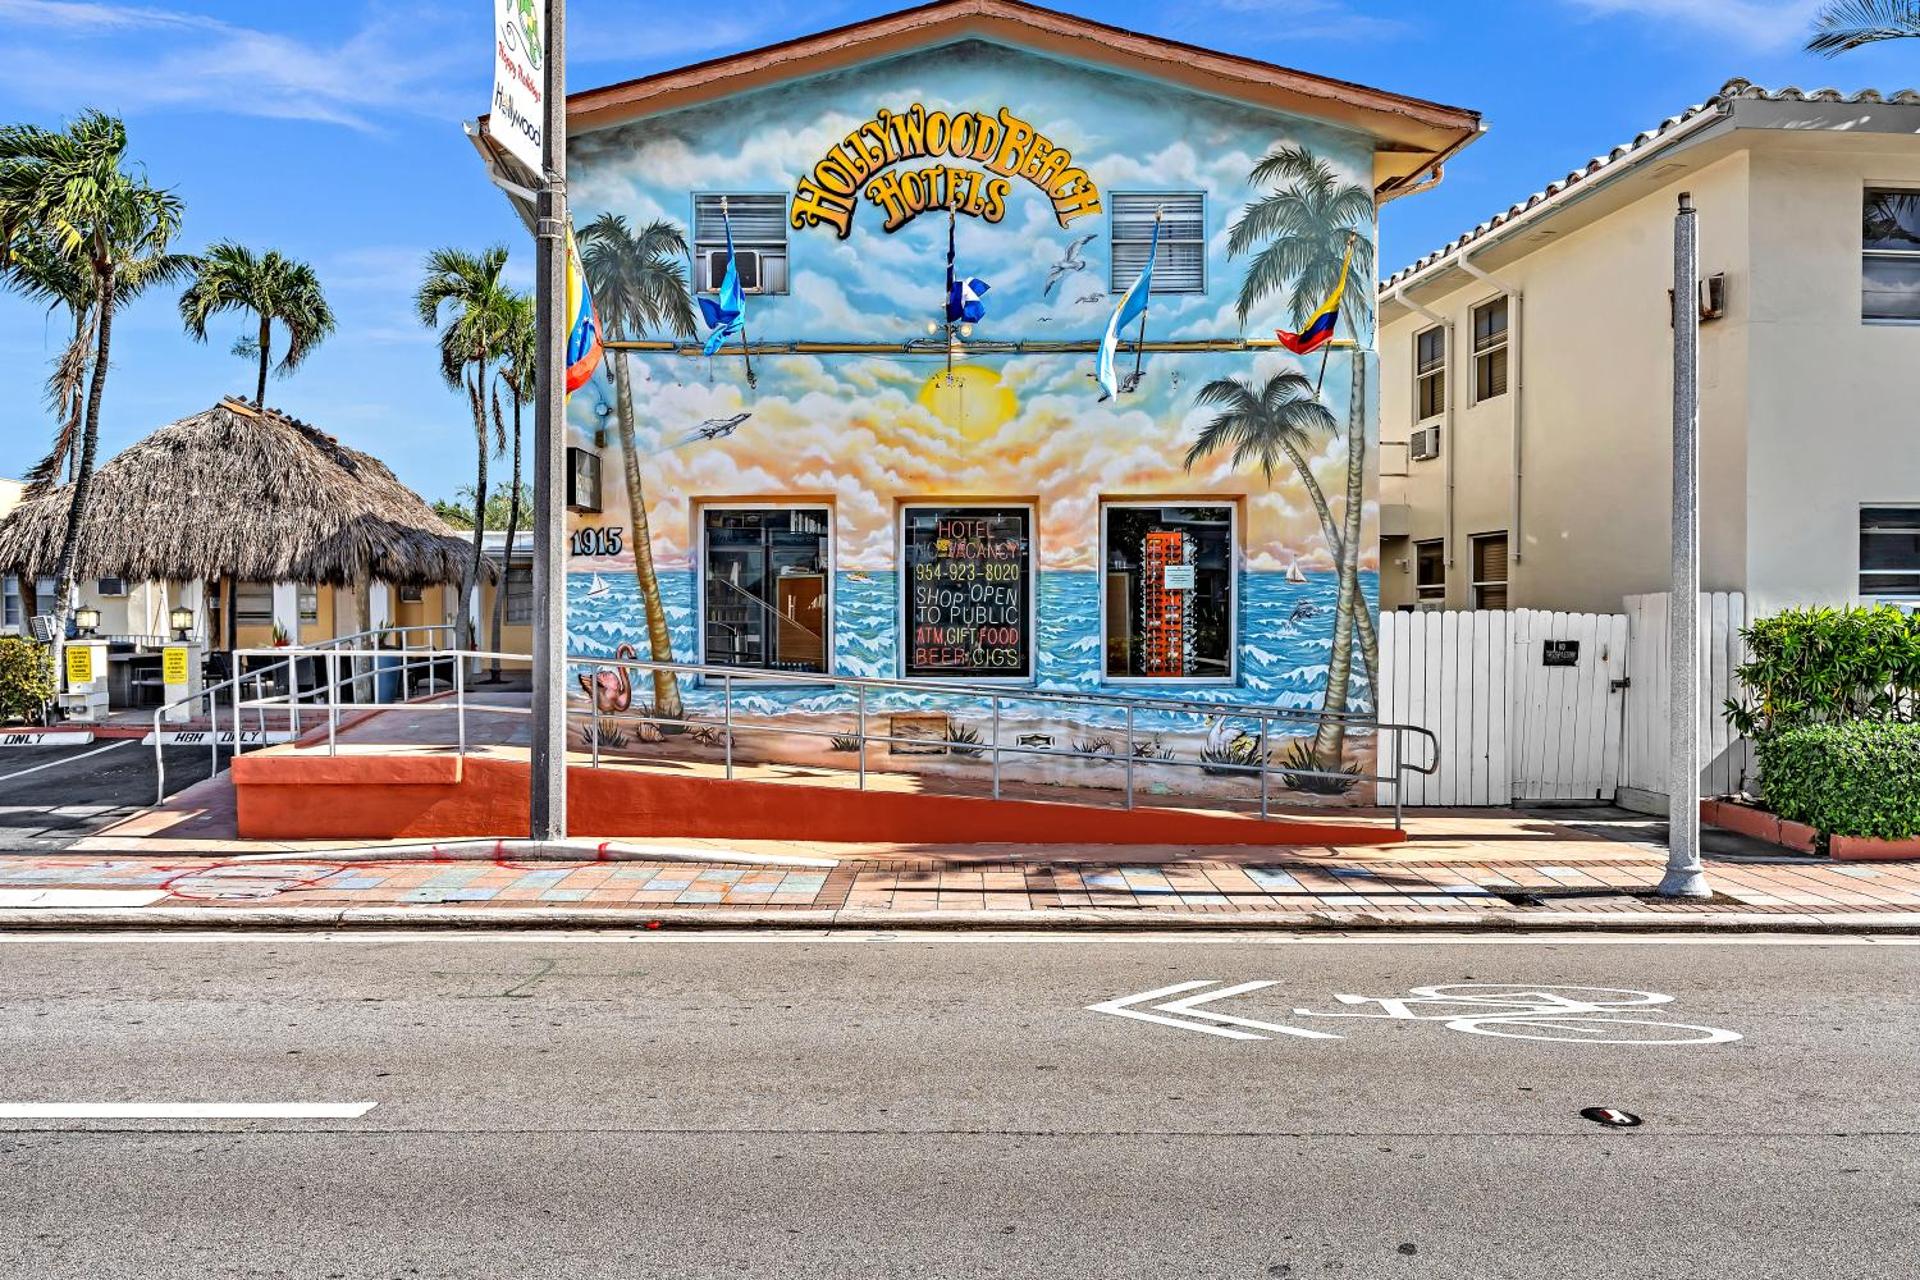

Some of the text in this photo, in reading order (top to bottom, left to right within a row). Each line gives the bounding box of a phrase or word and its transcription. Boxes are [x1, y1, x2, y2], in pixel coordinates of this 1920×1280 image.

[494, 82, 541, 148] Hollywood
[791, 103, 1103, 240] HOLLYWOOD BEACH
[865, 165, 1011, 233] HOTELS
[937, 520, 995, 539] HOTEL
[571, 527, 623, 556] 1915
[915, 542, 1019, 560] NO VACANCY
[916, 563, 1019, 581] 954-923-8020
[917, 584, 1017, 607] SHOP OPEN
[917, 606, 1019, 625] TO PUBLIC
[4, 733, 45, 745] ONLY
